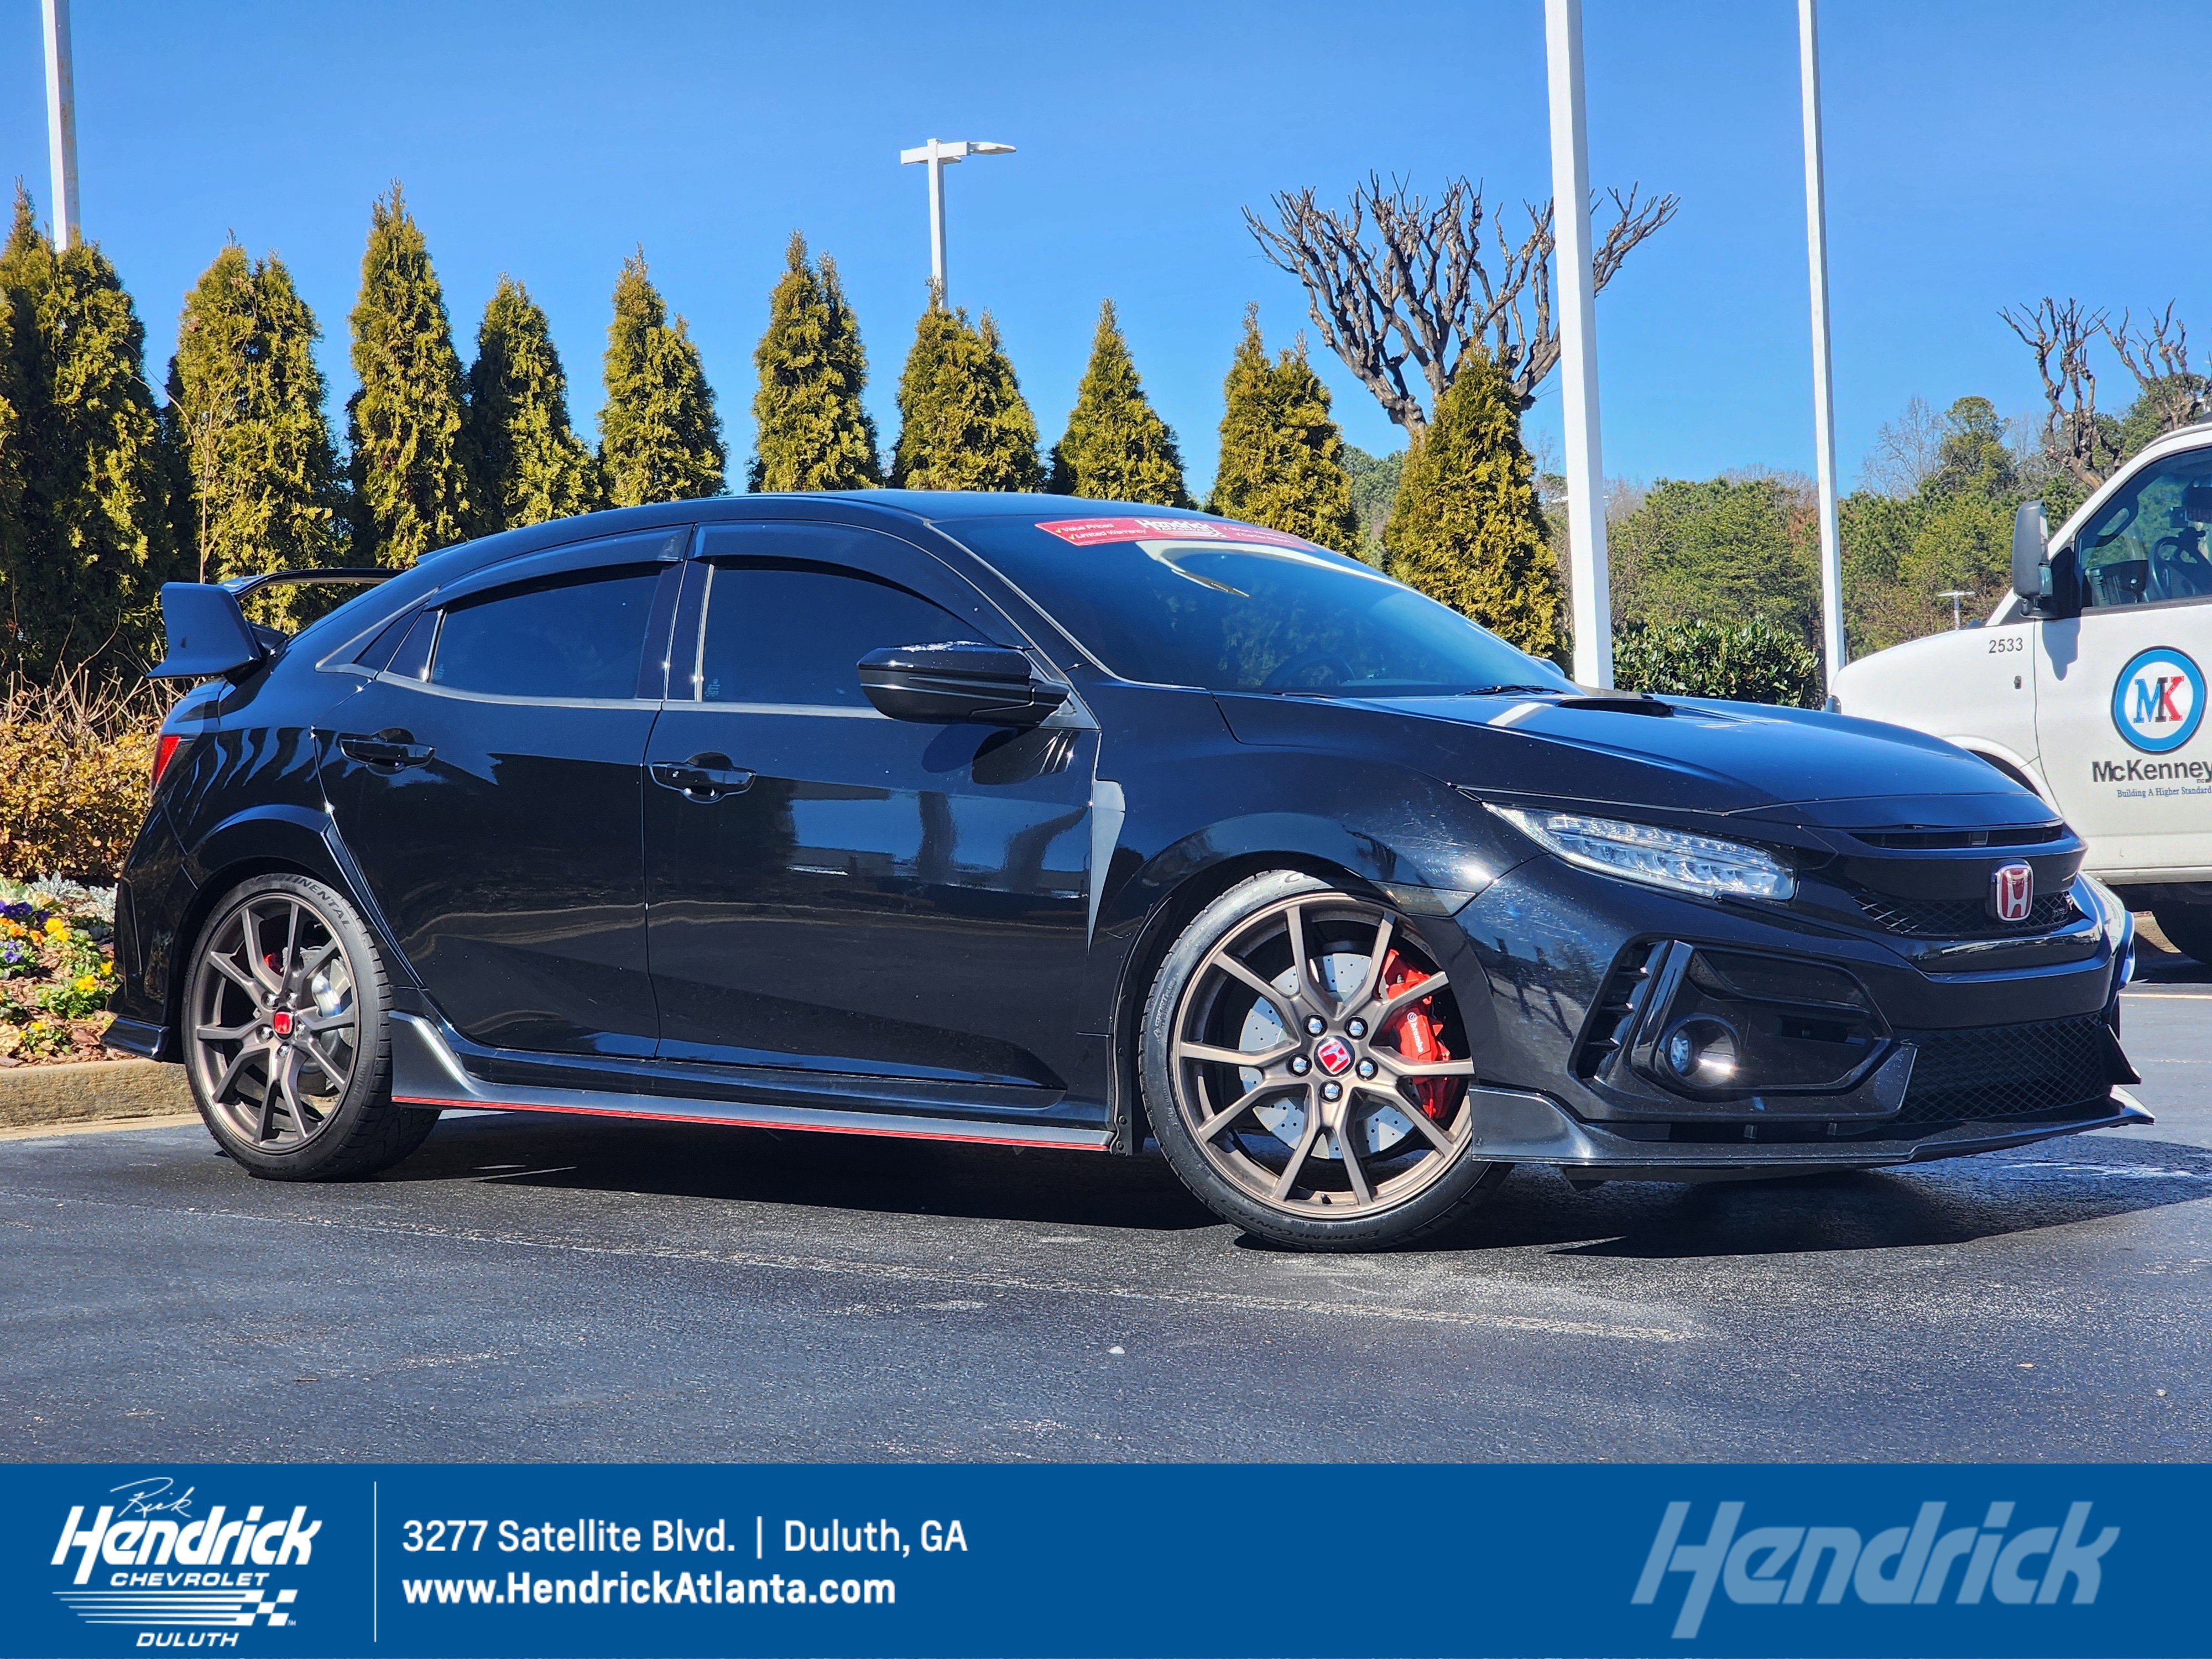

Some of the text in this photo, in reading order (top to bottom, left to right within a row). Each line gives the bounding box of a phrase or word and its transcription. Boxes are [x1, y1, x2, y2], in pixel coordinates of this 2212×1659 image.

[1989, 638, 2023, 654] 2533
[2133, 676, 2184, 724] MK
[2117, 789, 2146, 799] Building
[2156, 787, 2179, 797] Higher
[2181, 786, 2212, 795] Standard
[1410, 1022, 1424, 1052] brembo
